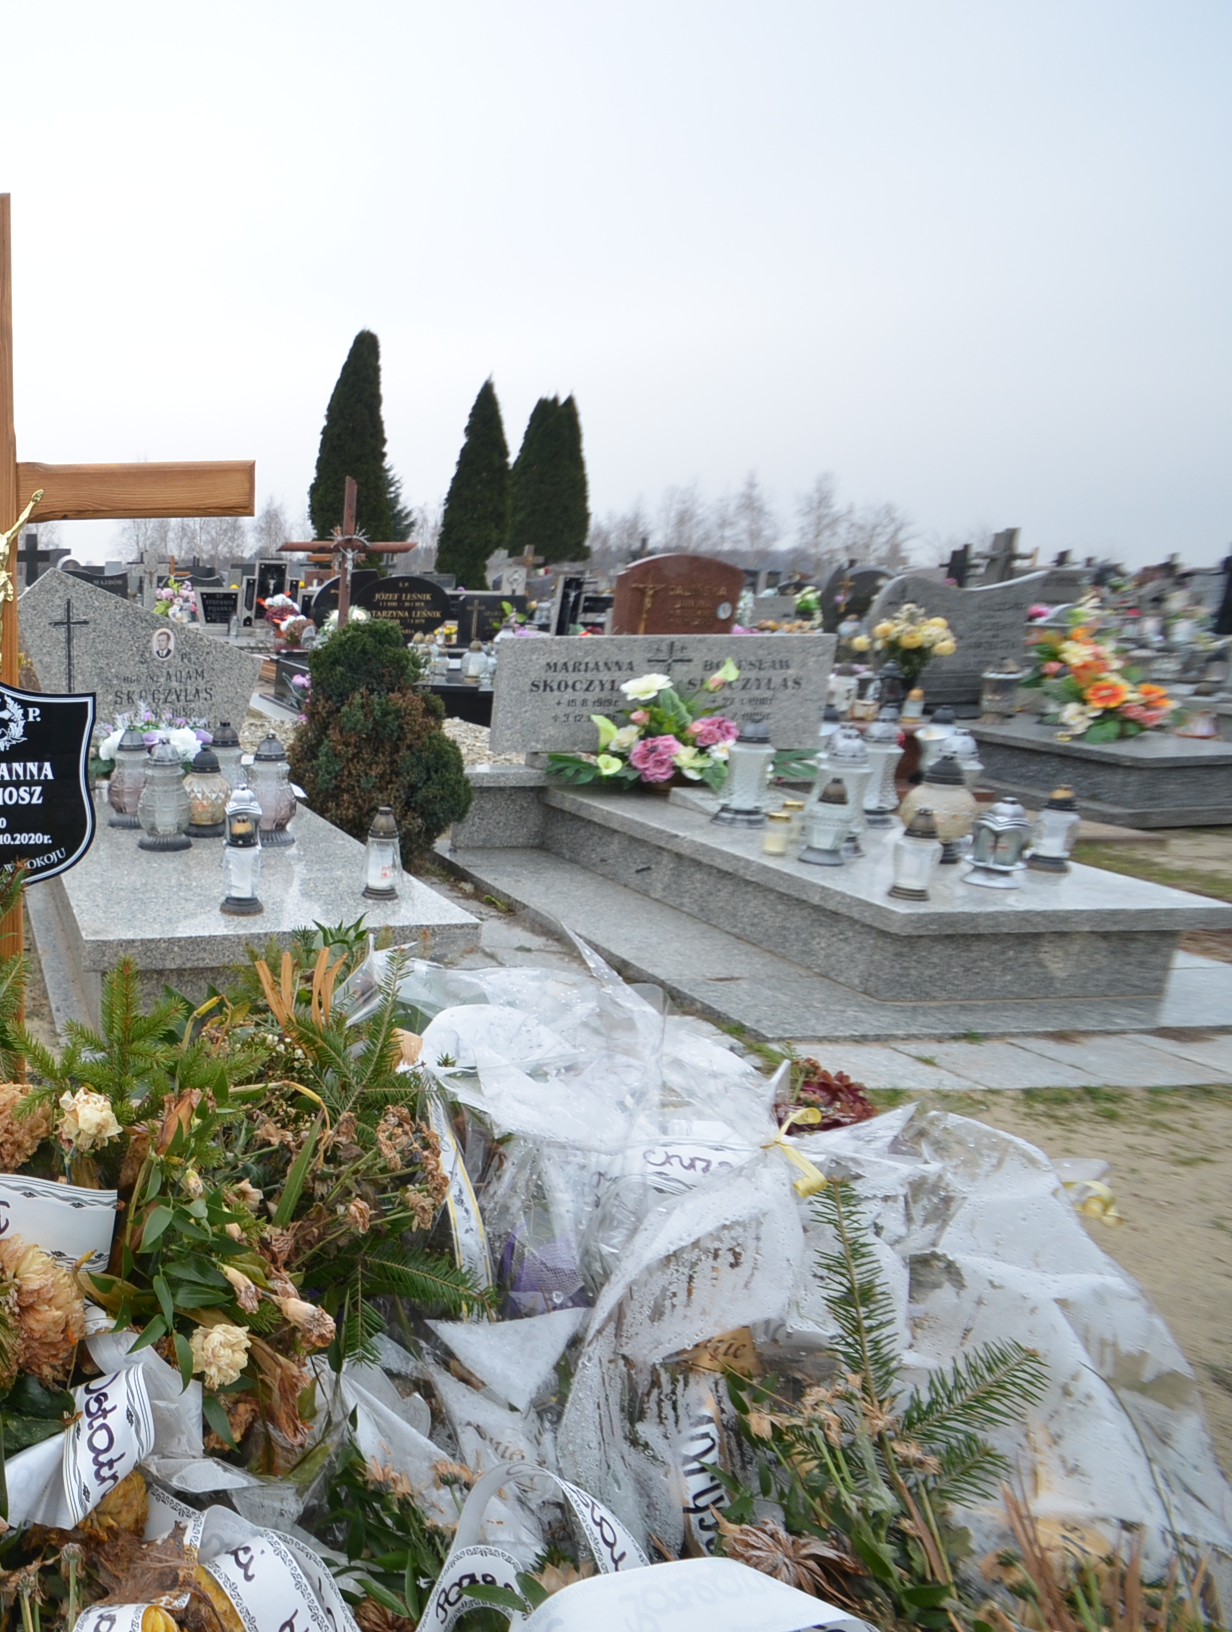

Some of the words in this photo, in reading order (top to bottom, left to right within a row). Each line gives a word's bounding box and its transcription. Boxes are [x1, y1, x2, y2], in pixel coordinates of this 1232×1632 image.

[545, 660, 635, 673] MARIANNA
[530, 679, 621, 693] SKOCZYL
[114, 686, 214, 706] SKOCZYLAS
[27, 707, 42, 722] P.
[24, 847, 67, 870] OKOJU
